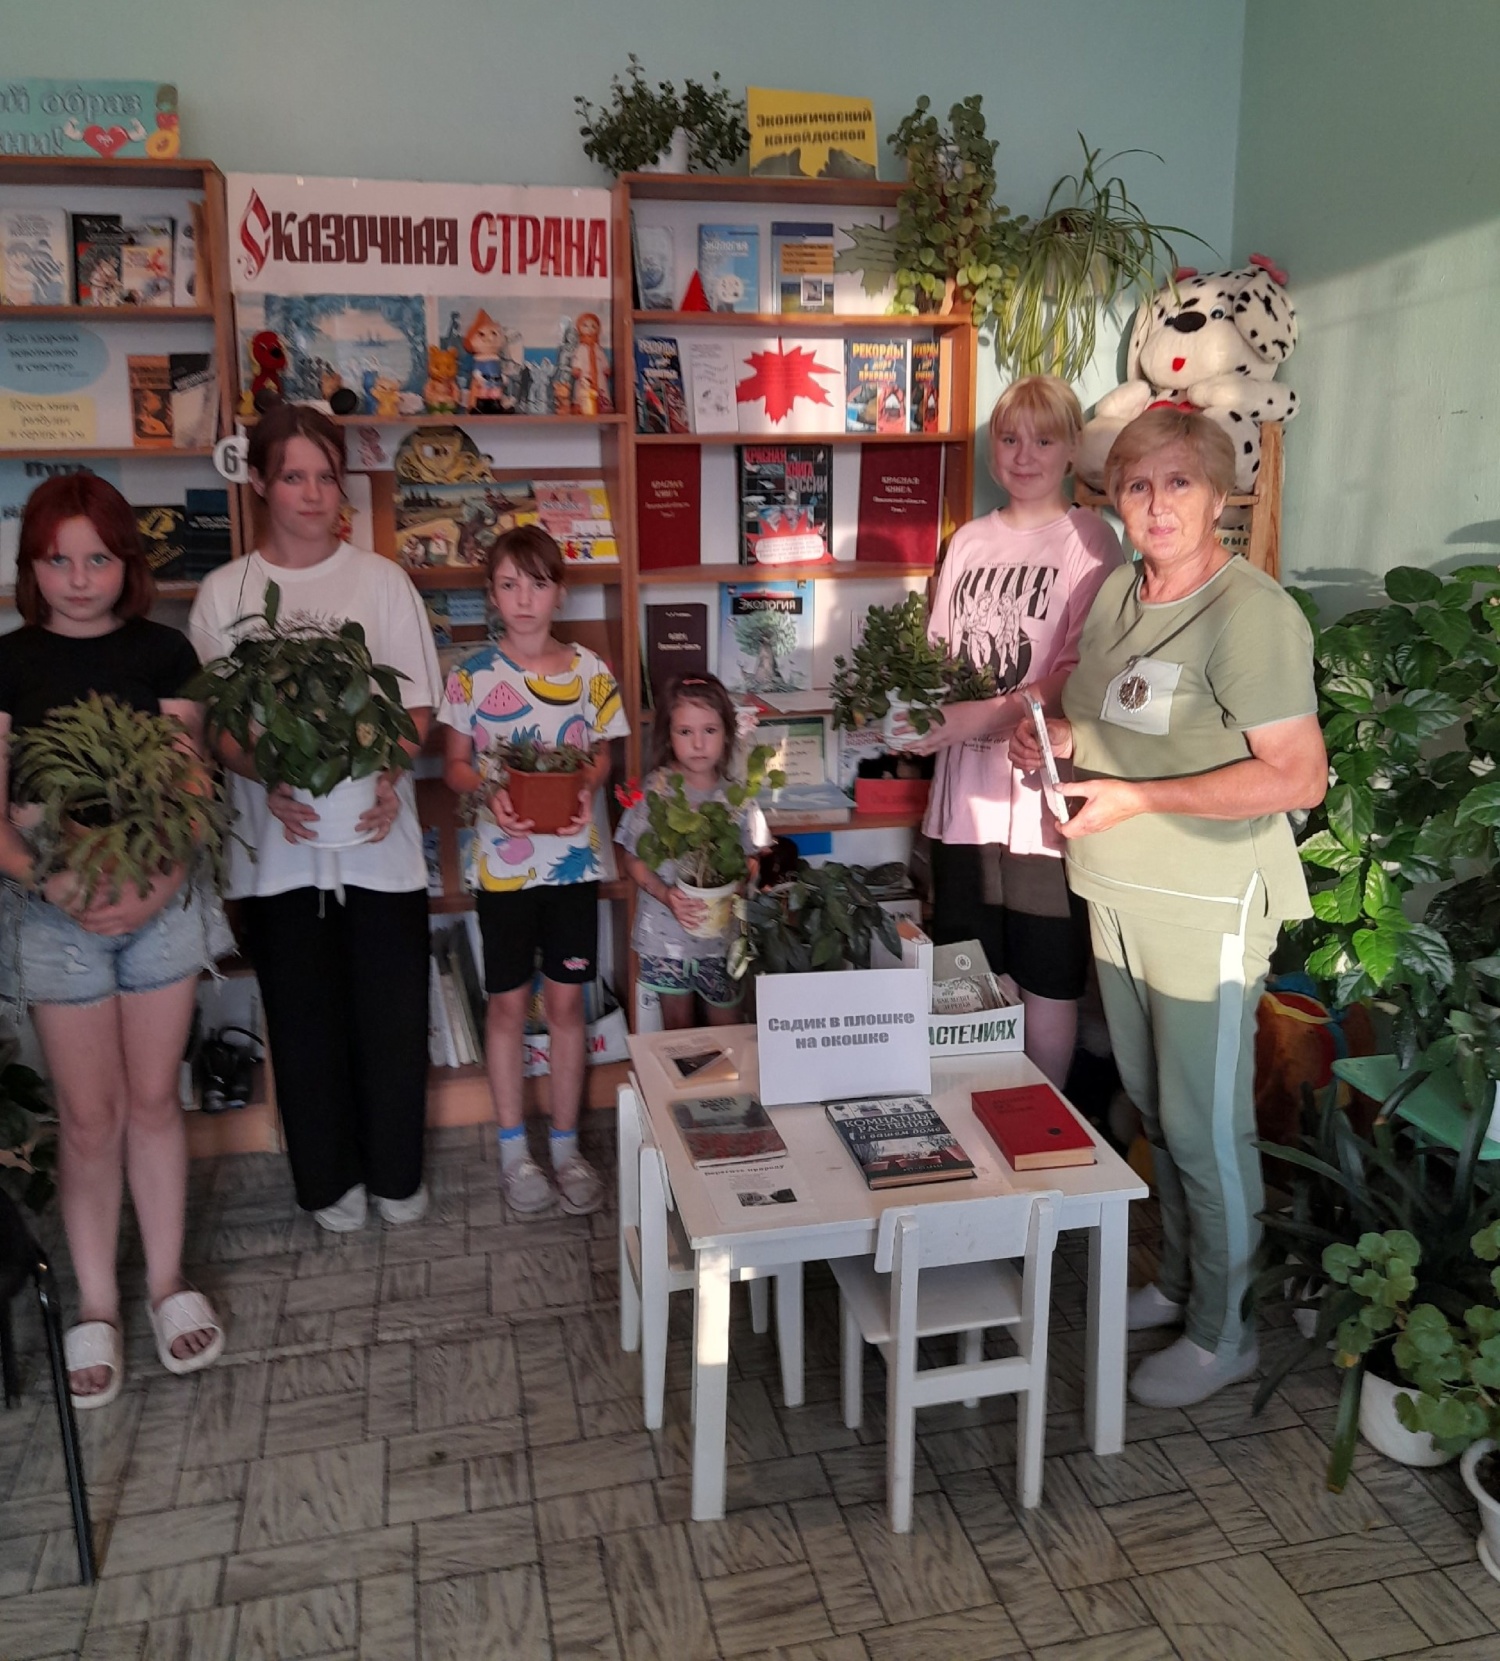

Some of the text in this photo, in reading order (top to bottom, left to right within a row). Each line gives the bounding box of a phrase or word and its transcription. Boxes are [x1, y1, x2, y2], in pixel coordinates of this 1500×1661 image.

[756, 107, 872, 128] Экологический
[0, 127, 65, 156] ни!
[764, 129, 866, 147] калейдоскоп
[237, 187, 608, 281] СКАЗОЧНАЯ СТРАНА
[852, 342, 904, 360] РЕКОРДЫ
[744, 448, 786, 463] КРАСНАЯ
[785, 461, 813, 478] КНИГА
[785, 476, 828, 494] РОССИИ
[768, 1012, 915, 1032] Садик в плошке
[795, 1031, 889, 1049] на окошке
[844, 1110, 938, 1128] КОМНАТНЫЕ
[857, 1119, 934, 1133] РАСТЕНИЯ
[912, 1126, 940, 1134] доме
